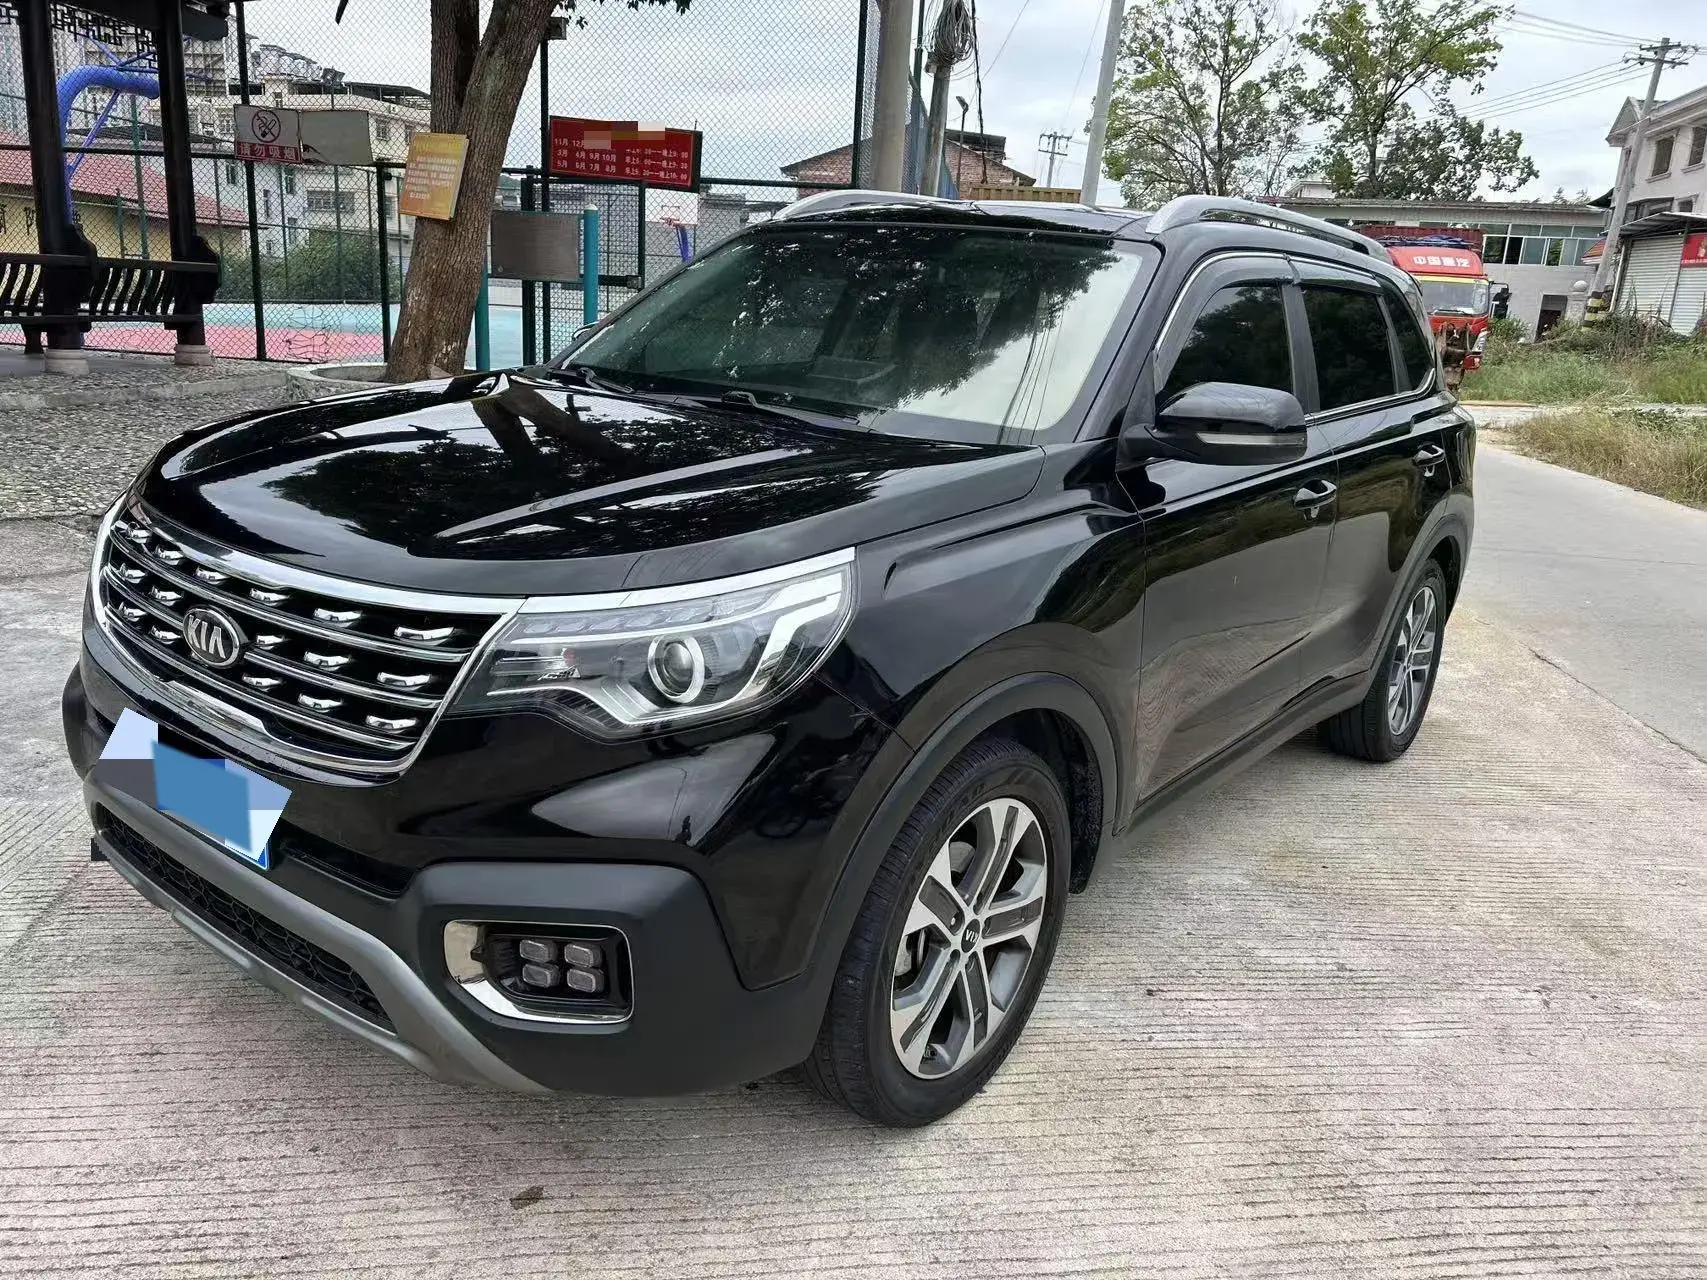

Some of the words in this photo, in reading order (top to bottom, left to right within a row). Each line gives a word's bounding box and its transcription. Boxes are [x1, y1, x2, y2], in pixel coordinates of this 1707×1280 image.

[554, 138, 568, 146] 11月
[239, 143, 294, 160] 请勿吸烟
[557, 149, 568, 157] 3月
[602, 154, 616, 162] 10月
[188, 614, 226, 659] KIA
